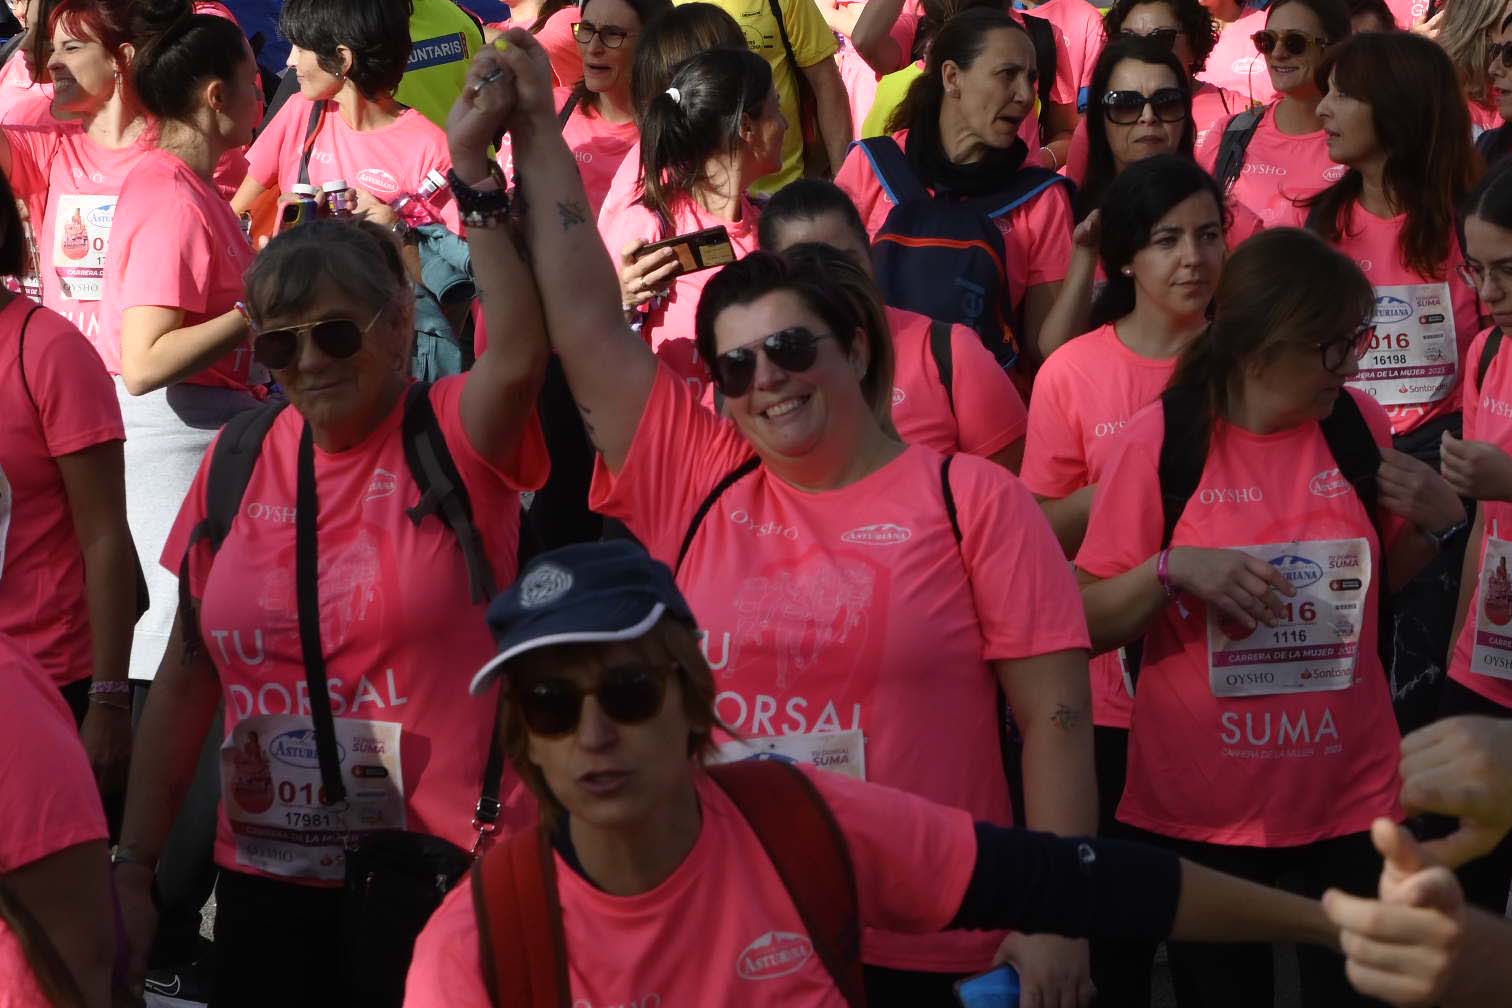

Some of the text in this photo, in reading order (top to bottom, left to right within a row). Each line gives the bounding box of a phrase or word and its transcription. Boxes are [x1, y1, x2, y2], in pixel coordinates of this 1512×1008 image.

[1416, 299, 1441, 308] SUMA
[1369, 333, 1411, 351] 016
[1373, 355, 1407, 365] 16198
[1376, 369, 1387, 378] DE
[1389, 369, 1399, 377] LA
[1400, 368, 1426, 377] MUJER
[1200, 486, 1263, 505] OYSHO
[1329, 559, 1360, 569] SUMA
[1273, 629, 1307, 644] 1116
[211, 629, 265, 665] TU
[1227, 652, 1272, 663] CARRERA
[1273, 651, 1287, 662] DE
[1288, 649, 1301, 660] LA
[1302, 648, 1335, 659] MUJER
[1226, 672, 1274, 687] OYSHO
[1221, 708, 1340, 745] SUMA
[353, 743, 386, 754] SUMA
[813, 754, 849, 766] SUMA
[284, 812, 331, 827] 17981
